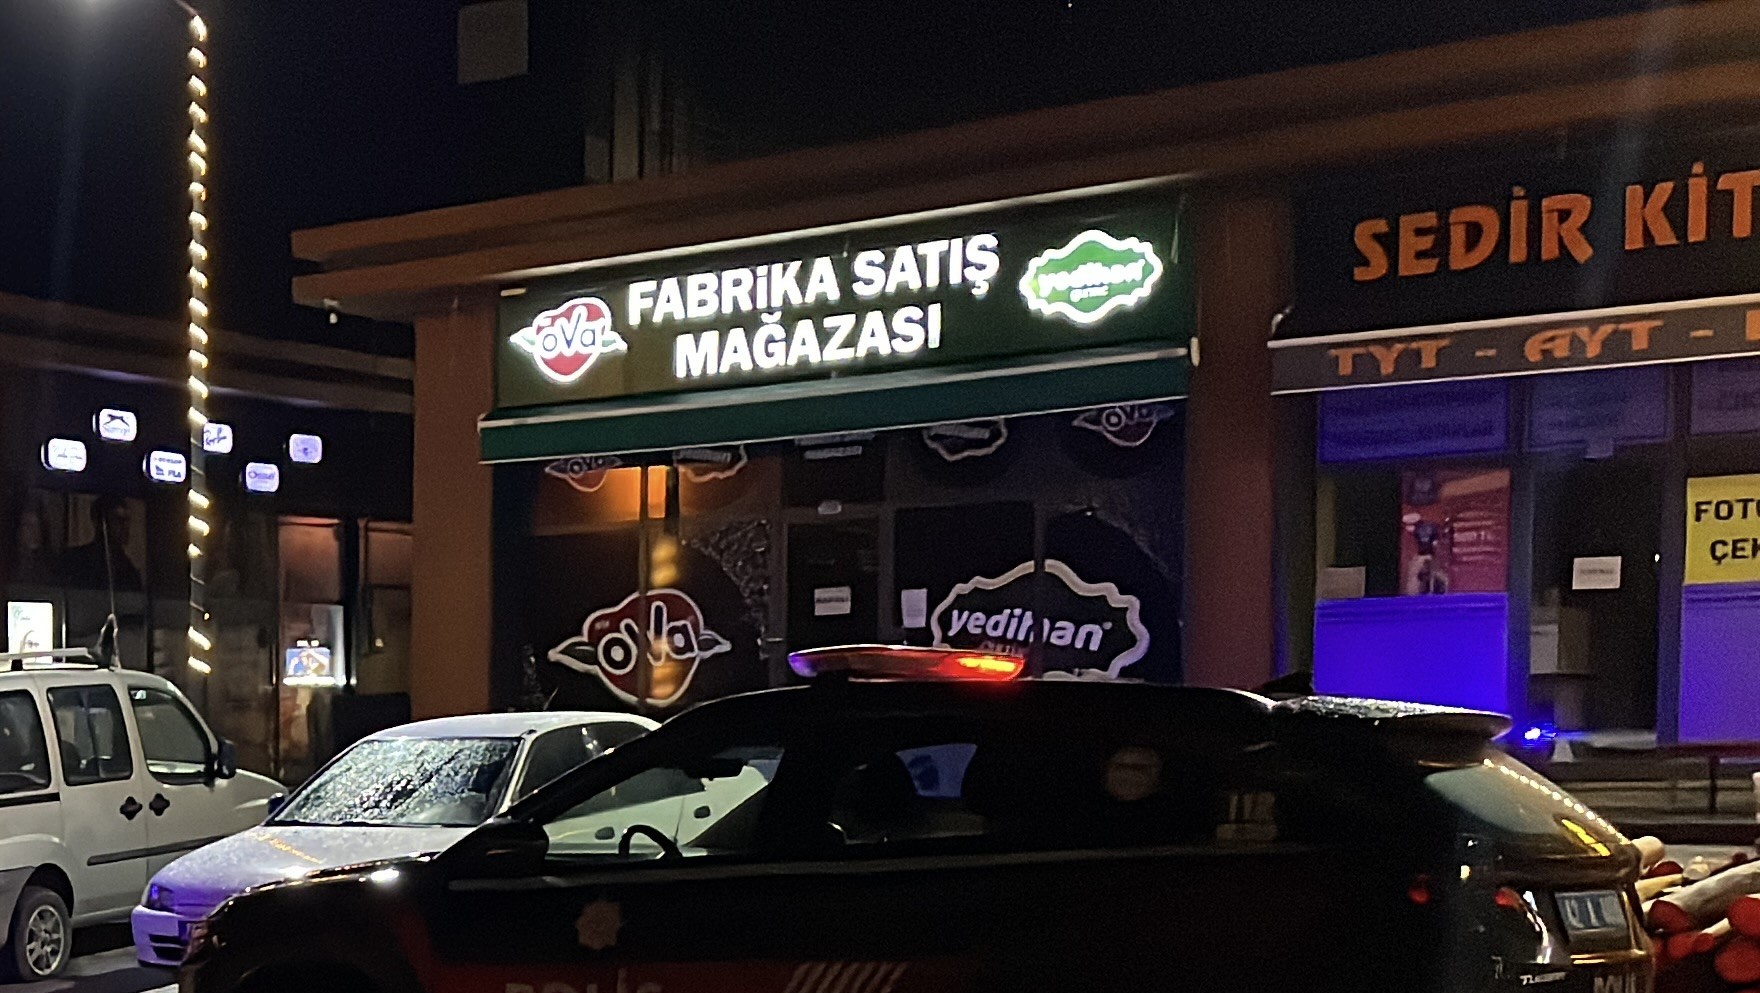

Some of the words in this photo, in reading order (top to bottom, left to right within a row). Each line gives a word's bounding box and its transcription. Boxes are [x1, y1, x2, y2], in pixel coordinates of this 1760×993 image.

[1352, 184, 1594, 281] SEDİR
[1624, 160, 1760, 251] KİT
[627, 259, 841, 326] FABRİKA
[851, 232, 1001, 297] SATIŞ
[673, 302, 942, 379] MAĞAZASI
[1328, 337, 1452, 377] TYT
[1524, 319, 1665, 363] AYT
[1694, 498, 1760, 523] FOT
